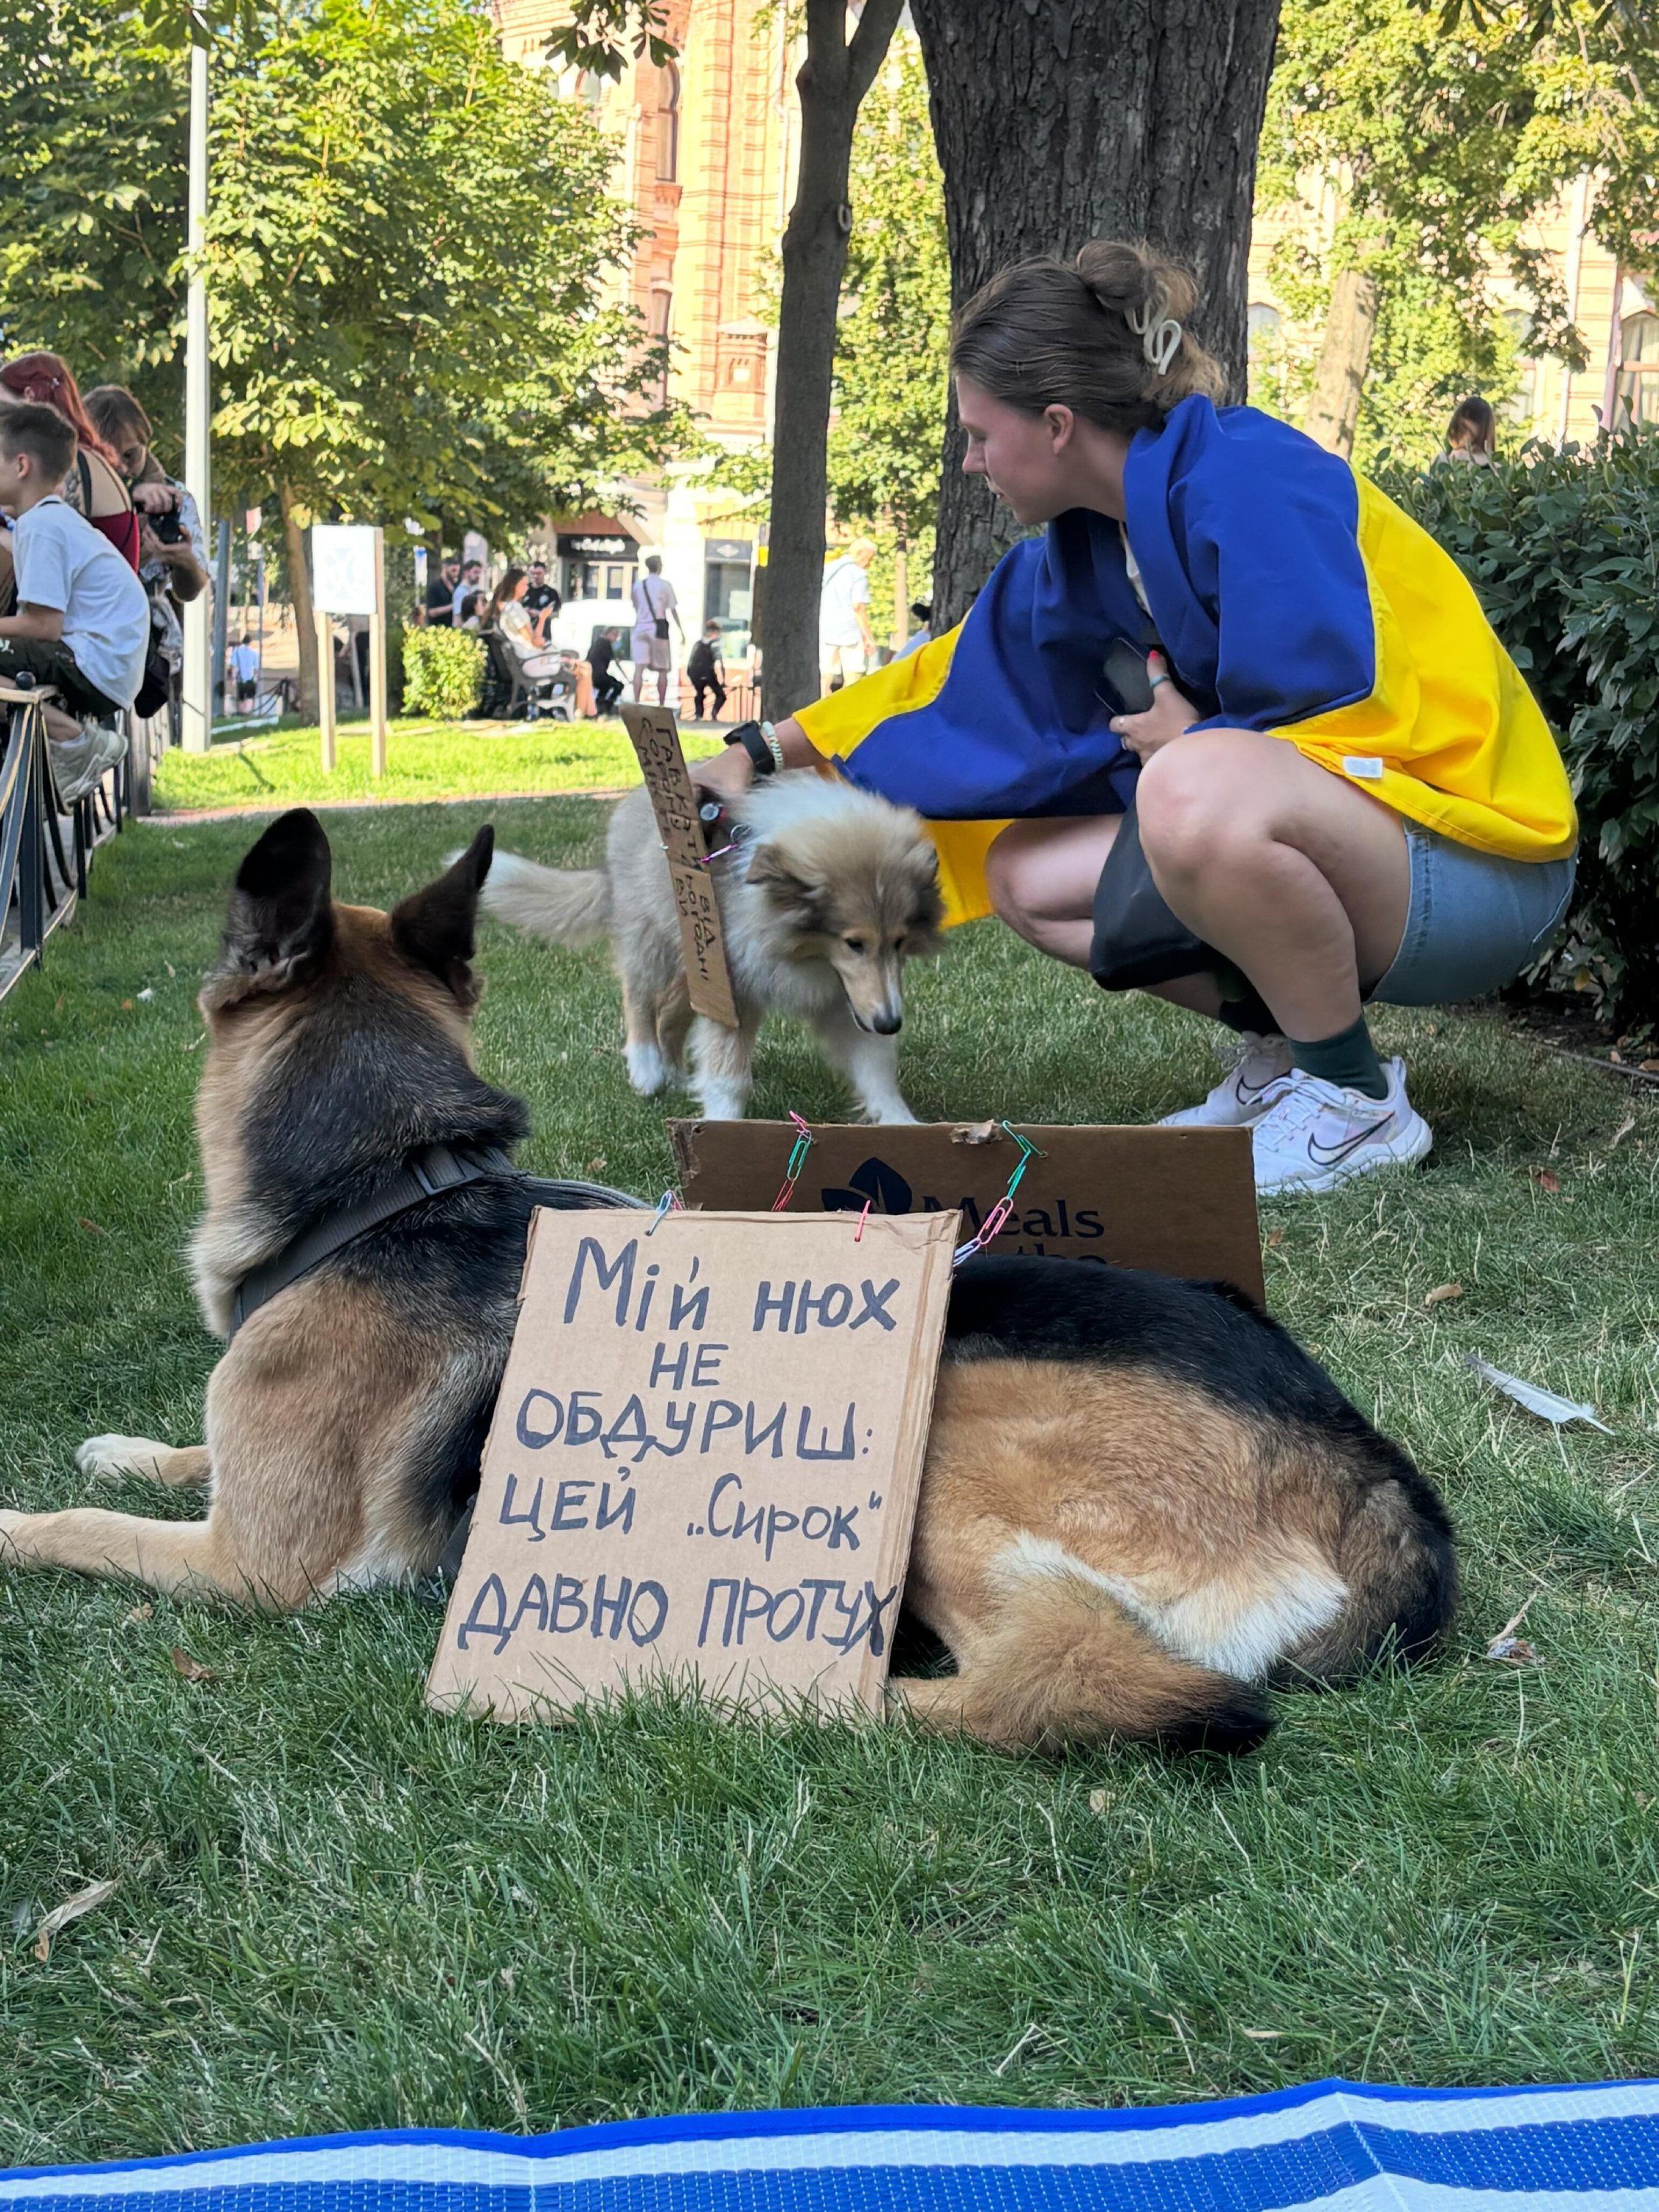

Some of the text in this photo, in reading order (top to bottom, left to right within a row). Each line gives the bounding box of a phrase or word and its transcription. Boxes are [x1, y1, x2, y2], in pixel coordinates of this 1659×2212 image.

[563, 1237, 711, 1332] Мій
[649, 1341, 728, 1390] НЕ
[516, 1388, 874, 1462] ОБДУРИШ:
[499, 1466, 636, 1542] ЦЕЙ
[457, 1572, 899, 1657] ДАВНО ПРОТУХ
